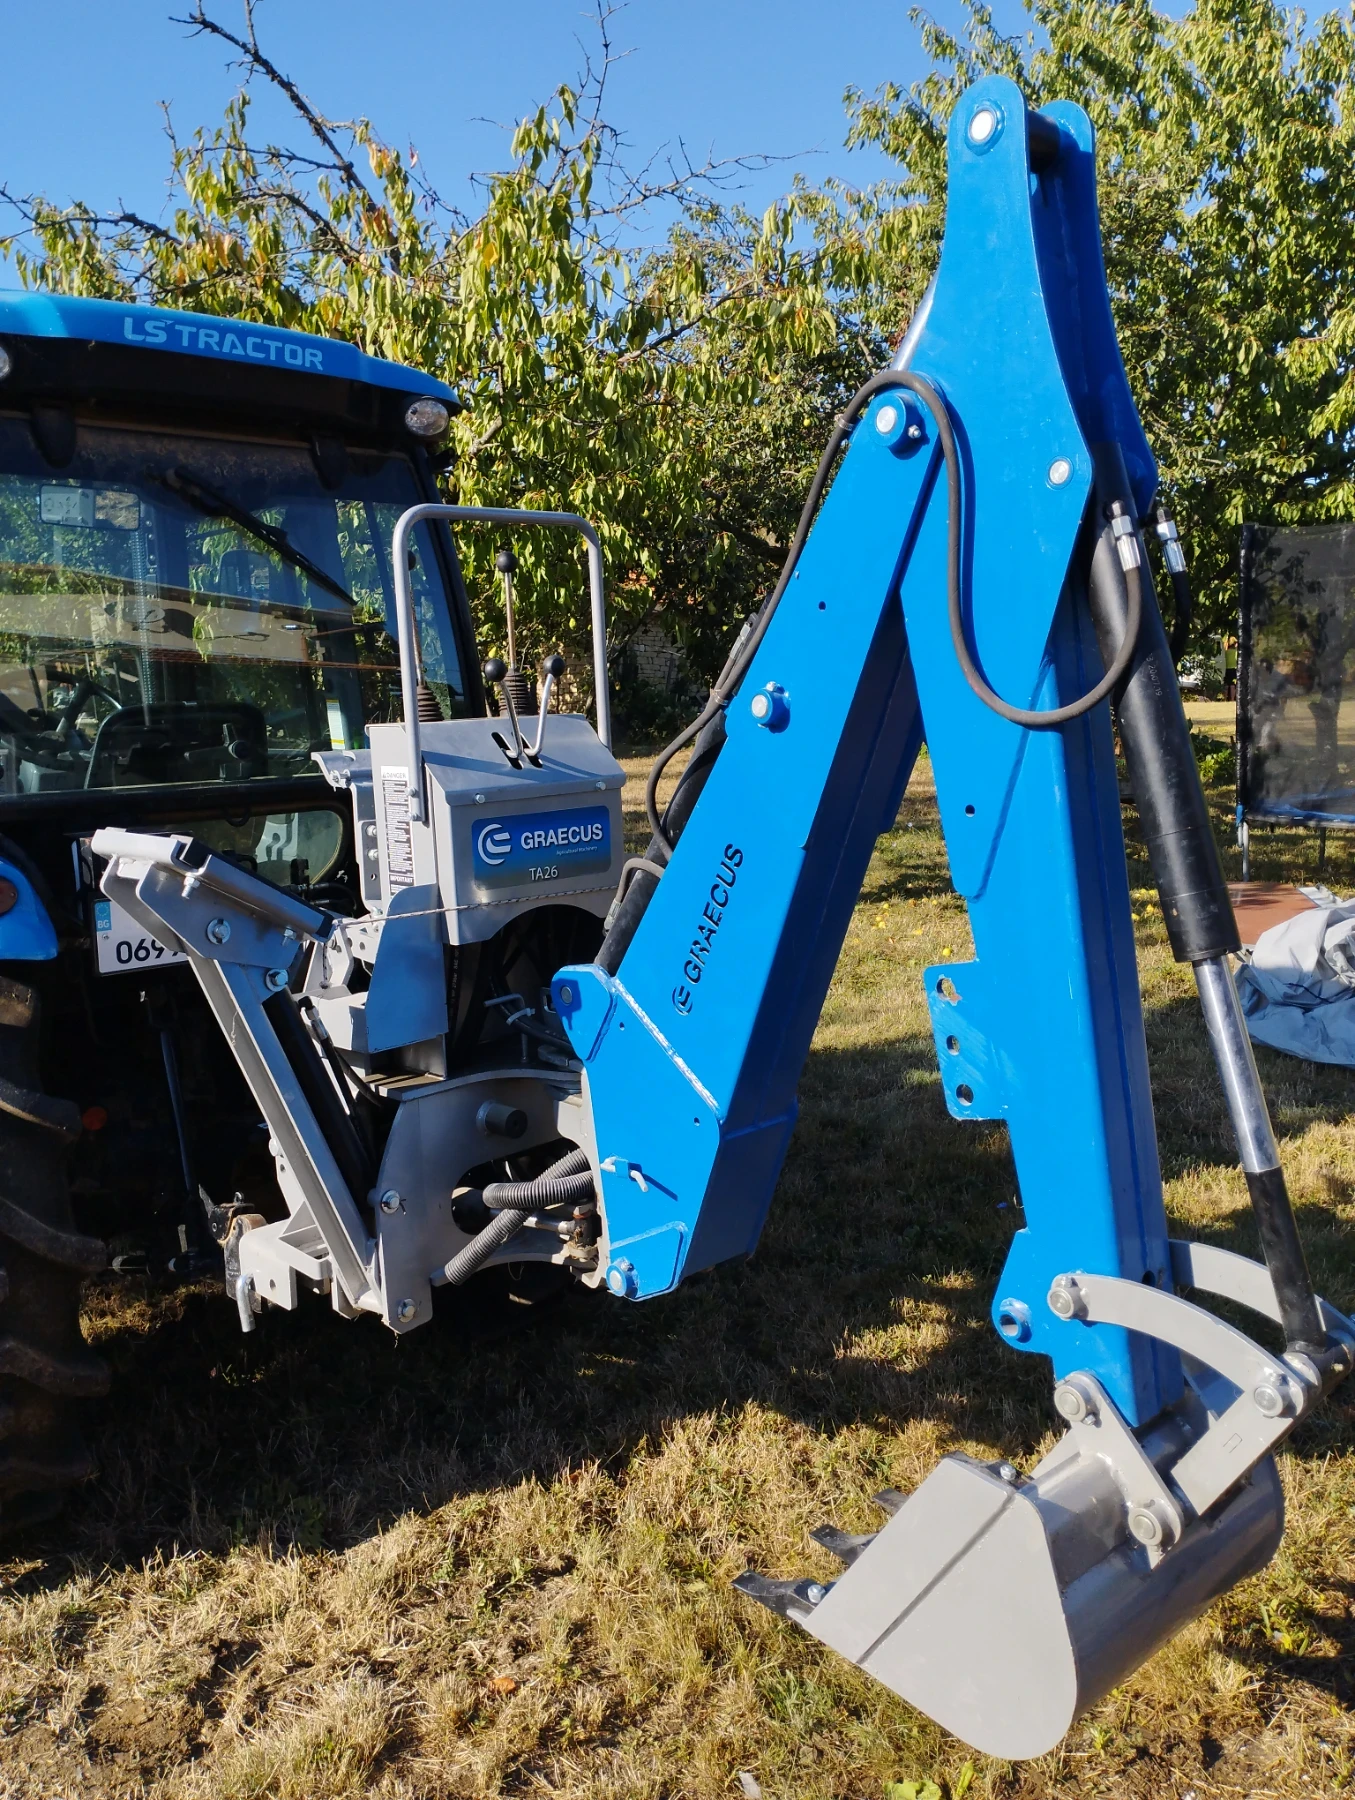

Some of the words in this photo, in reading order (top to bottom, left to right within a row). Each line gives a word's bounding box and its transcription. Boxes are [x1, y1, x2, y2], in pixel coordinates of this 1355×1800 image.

[123, 316, 169, 343] LS
[175, 324, 324, 371] TRACTOR
[520, 823, 603, 850] GRAECUS
[529, 865, 558, 880] TA26
[97, 919, 110, 929] BG
[683, 843, 744, 985] GRAECUS
[116, 938, 179, 964] 069
